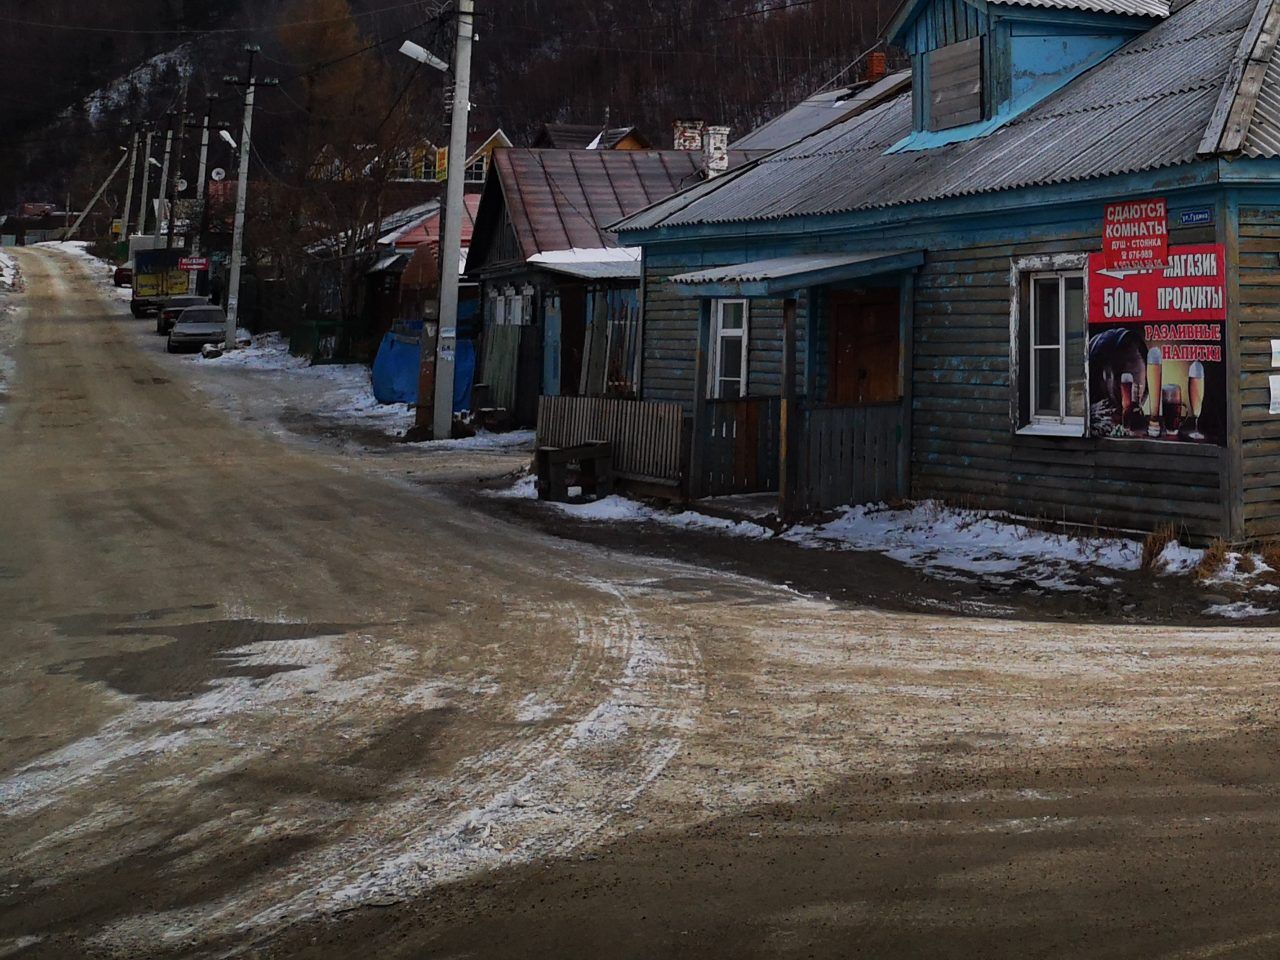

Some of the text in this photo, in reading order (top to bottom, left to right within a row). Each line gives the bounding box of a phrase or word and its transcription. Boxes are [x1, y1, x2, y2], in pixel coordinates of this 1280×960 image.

[1107, 202, 1165, 222] СДАЮТСЯ
[1105, 220, 1167, 238] КОМНАТЫ
[1111, 238, 1162, 250] ДУШ СТОЯНКА
[1163, 253, 1218, 278] МАГАЗИН
[1157, 286, 1223, 313] ПРОДУКТЫ
[1144, 324, 1221, 341] РАЗЛИВНЫЕ
[1161, 345, 1221, 362] НАПИТКИ
